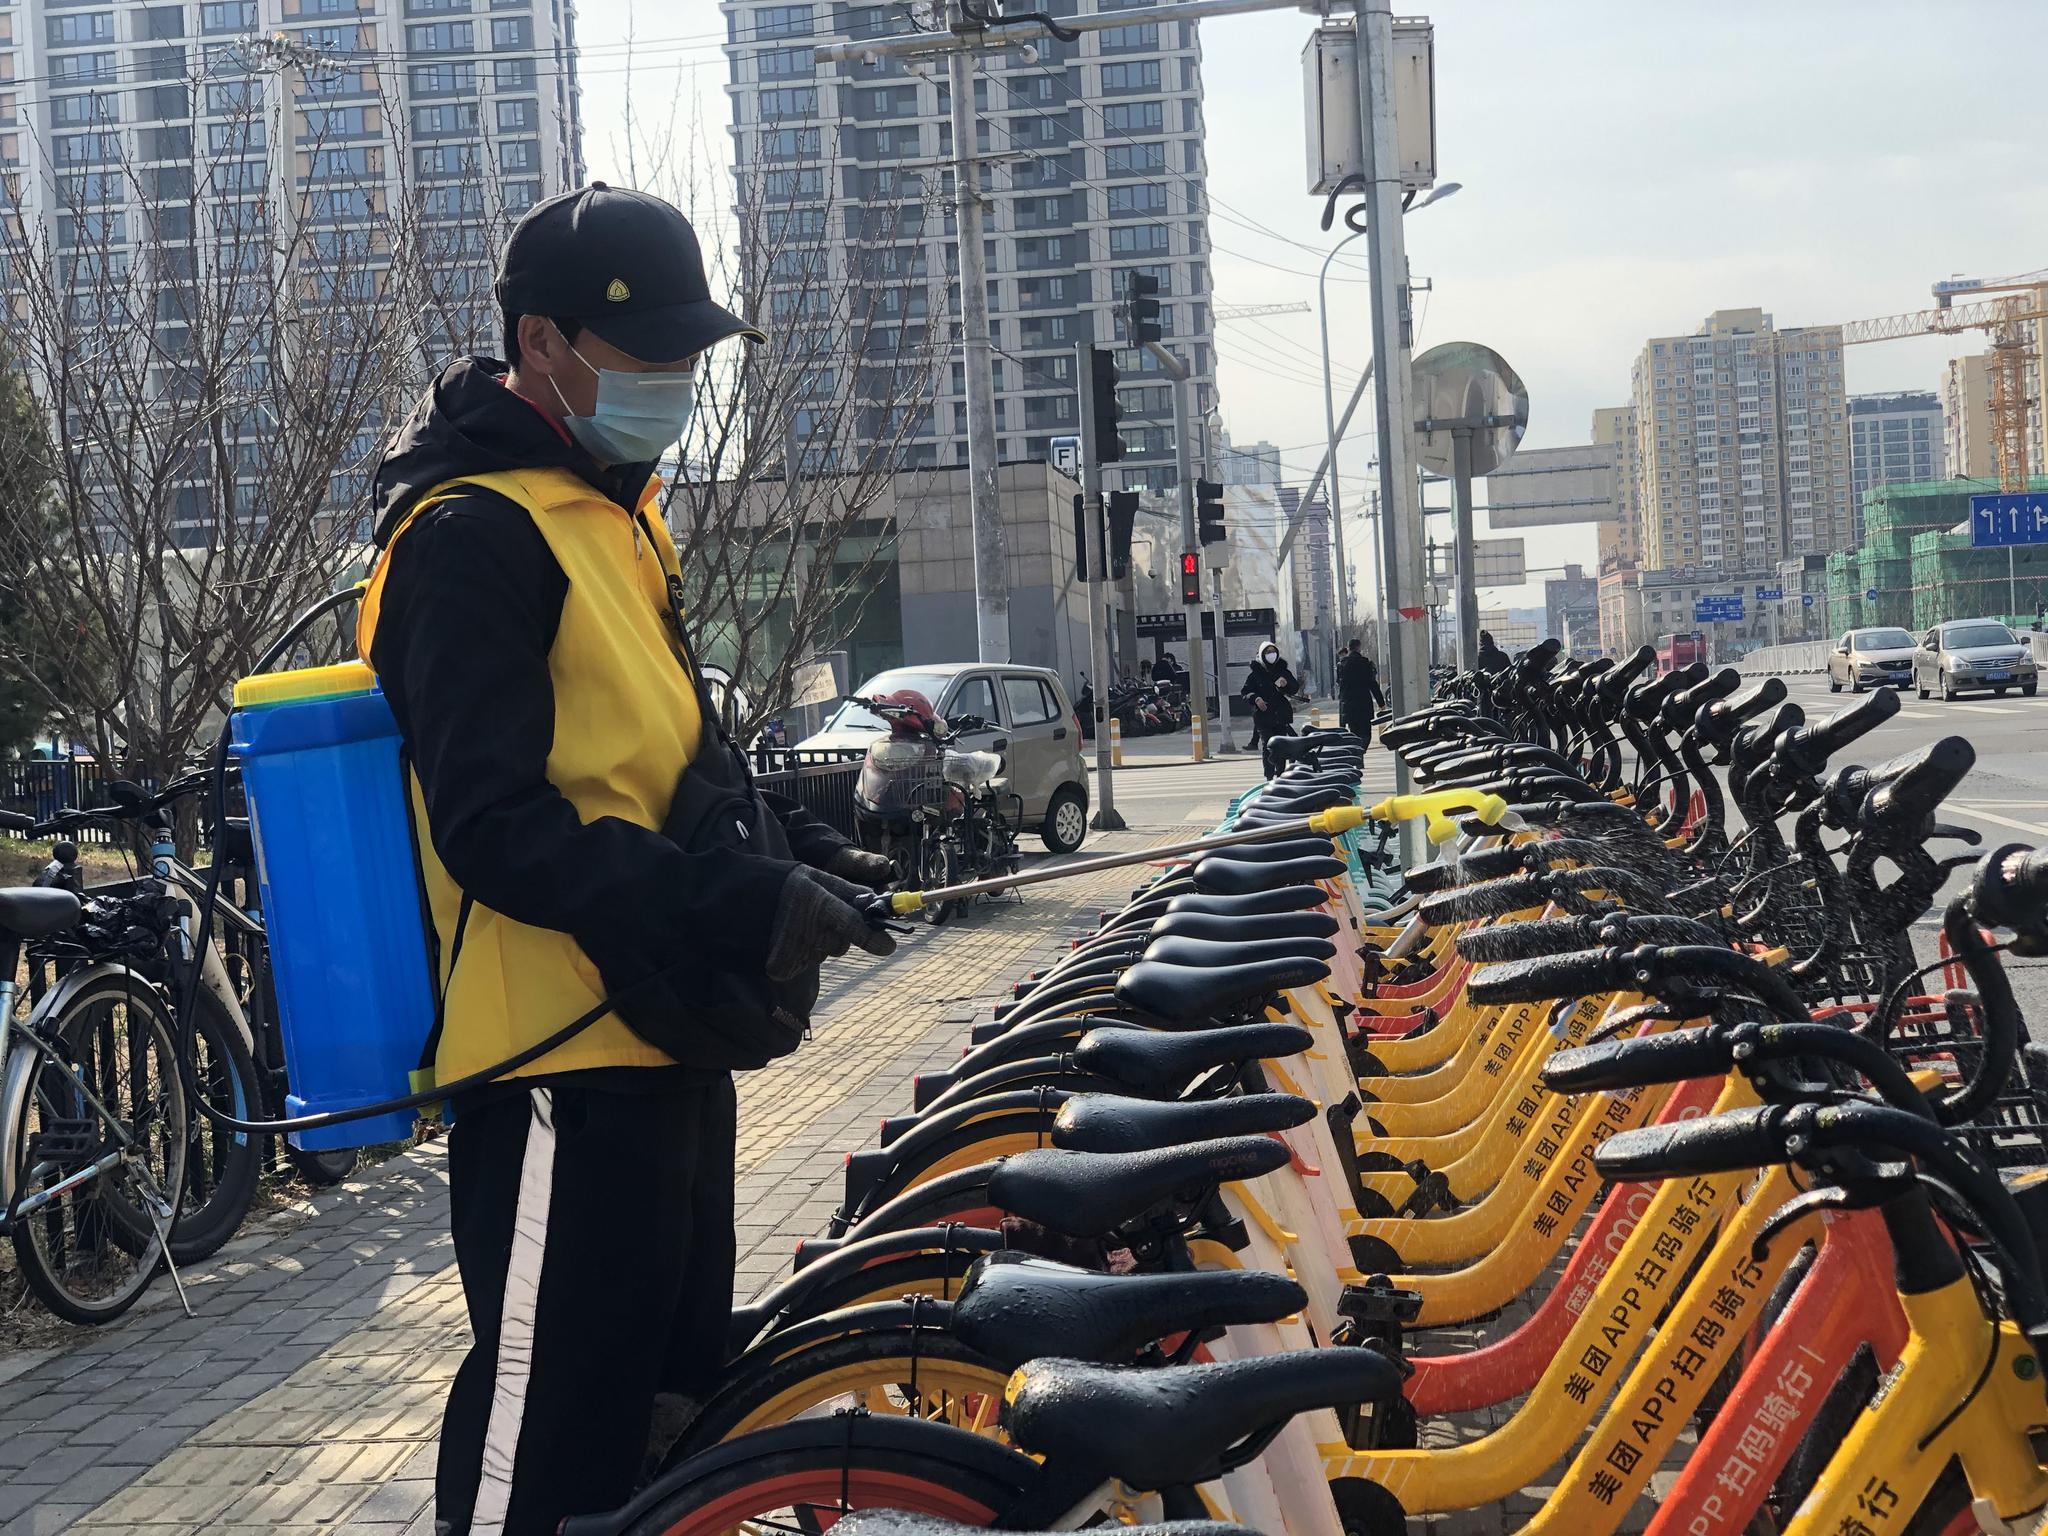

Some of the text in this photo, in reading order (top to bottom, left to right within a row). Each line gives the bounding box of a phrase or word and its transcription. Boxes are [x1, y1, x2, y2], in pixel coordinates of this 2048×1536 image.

[1058, 448, 1070, 466] F
[1484, 1008, 1531, 1078] 美团 APP
[1506, 1096, 1539, 1138] 美团
[1523, 1136, 1559, 1182] 美团
[1532, 1189, 1573, 1238] 美团
[1563, 1143, 1596, 1194] APP
[1563, 1343, 1613, 1405] 美团
[1601, 1287, 1642, 1349] APP
[1633, 1176, 1717, 1291] 扫码骑行
[1564, 1253, 1610, 1316] 摩拜
[1588, 1255, 1764, 1506] 美团 APP 扫码骑行
[1688, 1358, 1814, 1536] PP 扫码骑行
